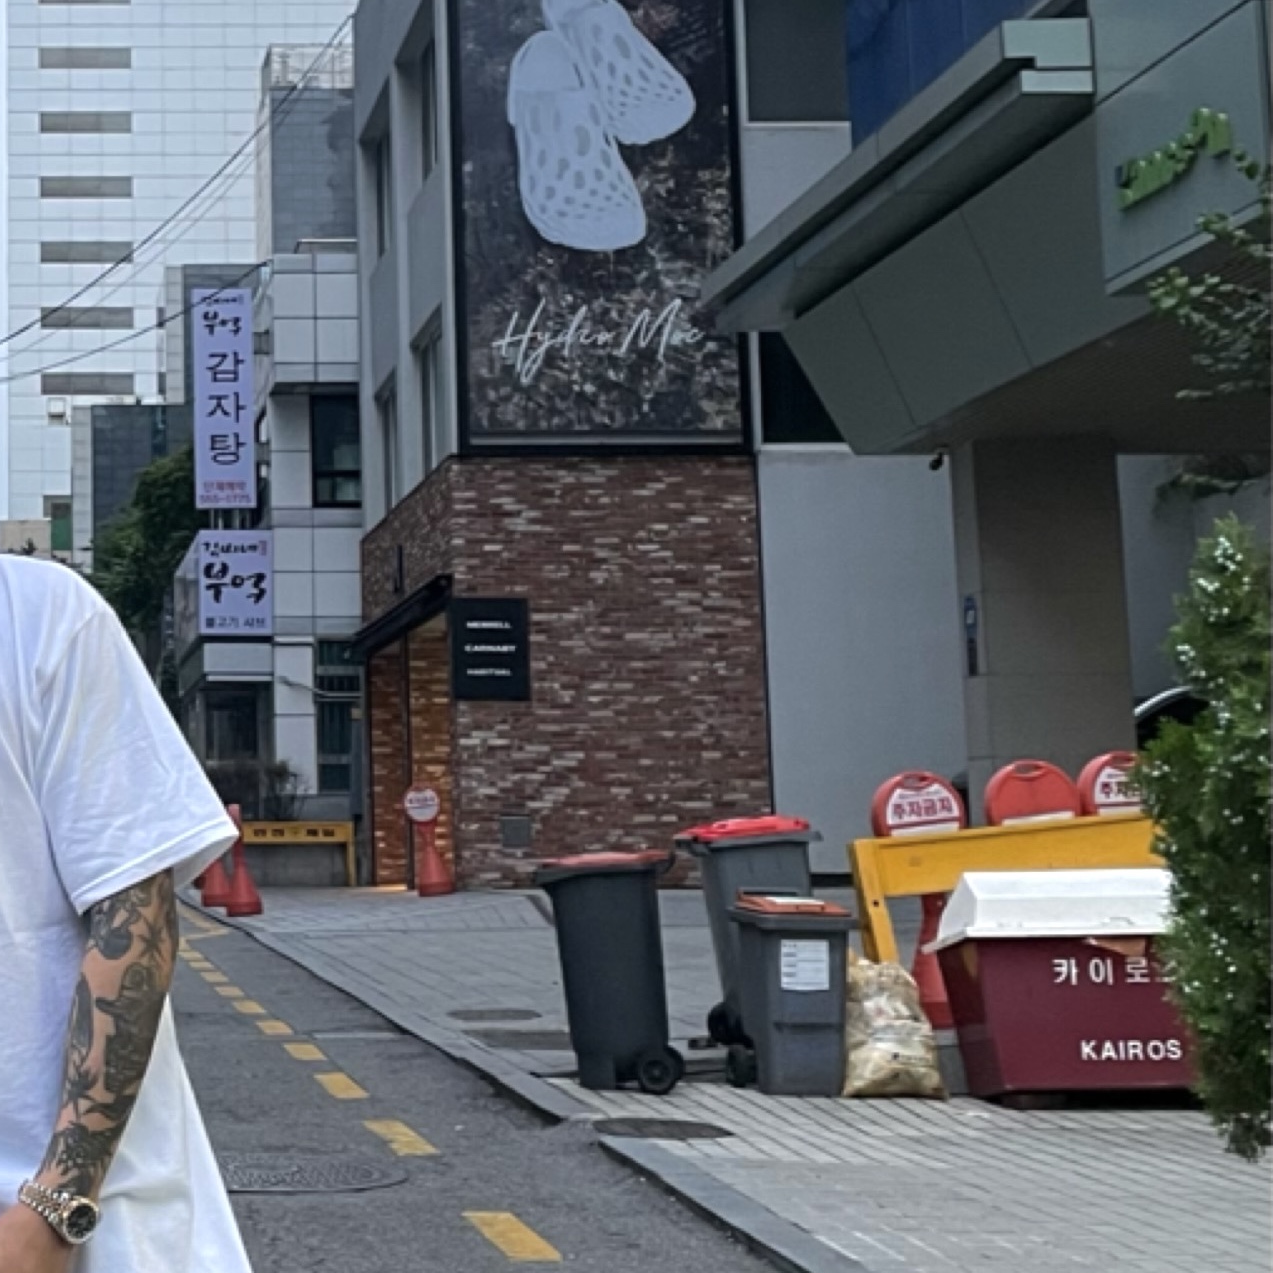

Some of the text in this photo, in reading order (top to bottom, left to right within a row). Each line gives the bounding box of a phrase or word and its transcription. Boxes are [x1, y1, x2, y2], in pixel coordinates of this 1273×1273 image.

[206, 350, 248, 466] 감자탕
[891, 796, 954, 820] 주차금지
[1080, 1039, 1183, 1061] KAIROS
